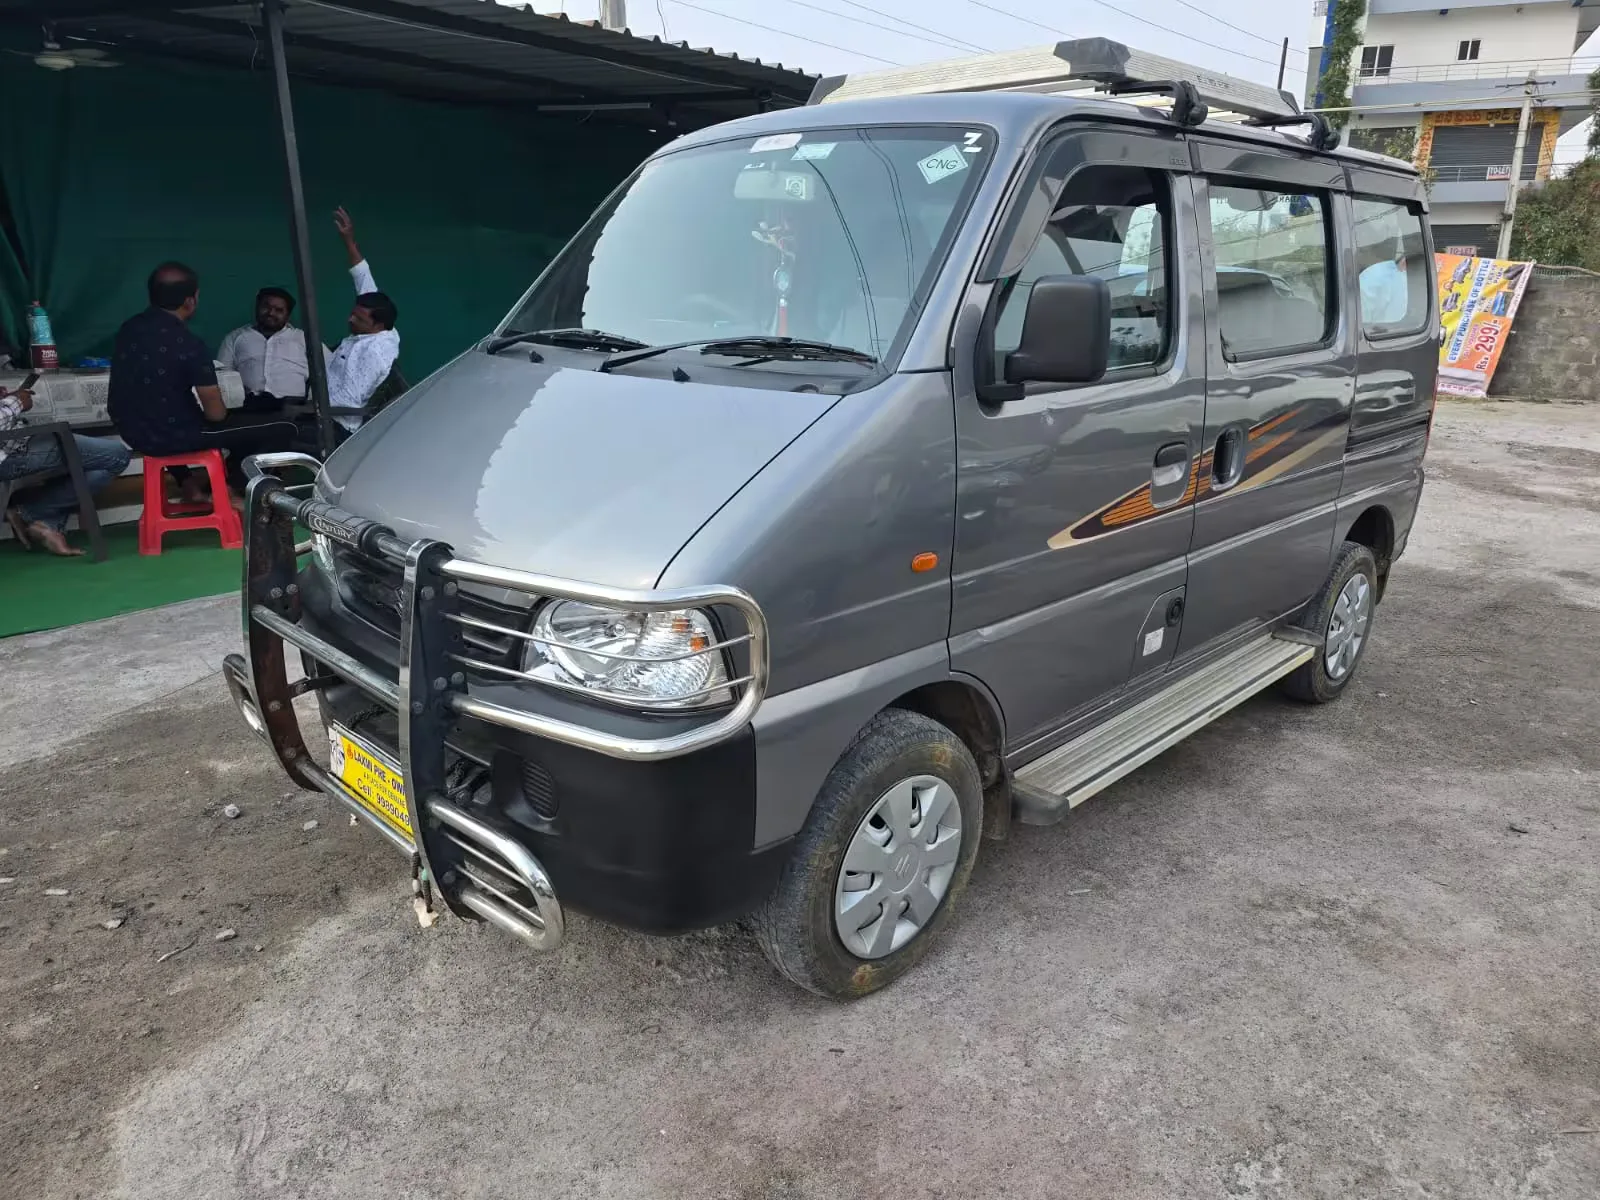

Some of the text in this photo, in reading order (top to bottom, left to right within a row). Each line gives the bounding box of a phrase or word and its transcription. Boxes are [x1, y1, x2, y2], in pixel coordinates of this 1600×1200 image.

[926, 158, 958, 170] CNG
[1475, 259, 1490, 287] BOTTLE
[1471, 287, 1480, 298] OF
[1475, 320, 1500, 353] 299/-
[1449, 338, 1463, 361] EVERY
[1476, 356, 1489, 370] Rs.
[353, 749, 373, 772] LAXMI
